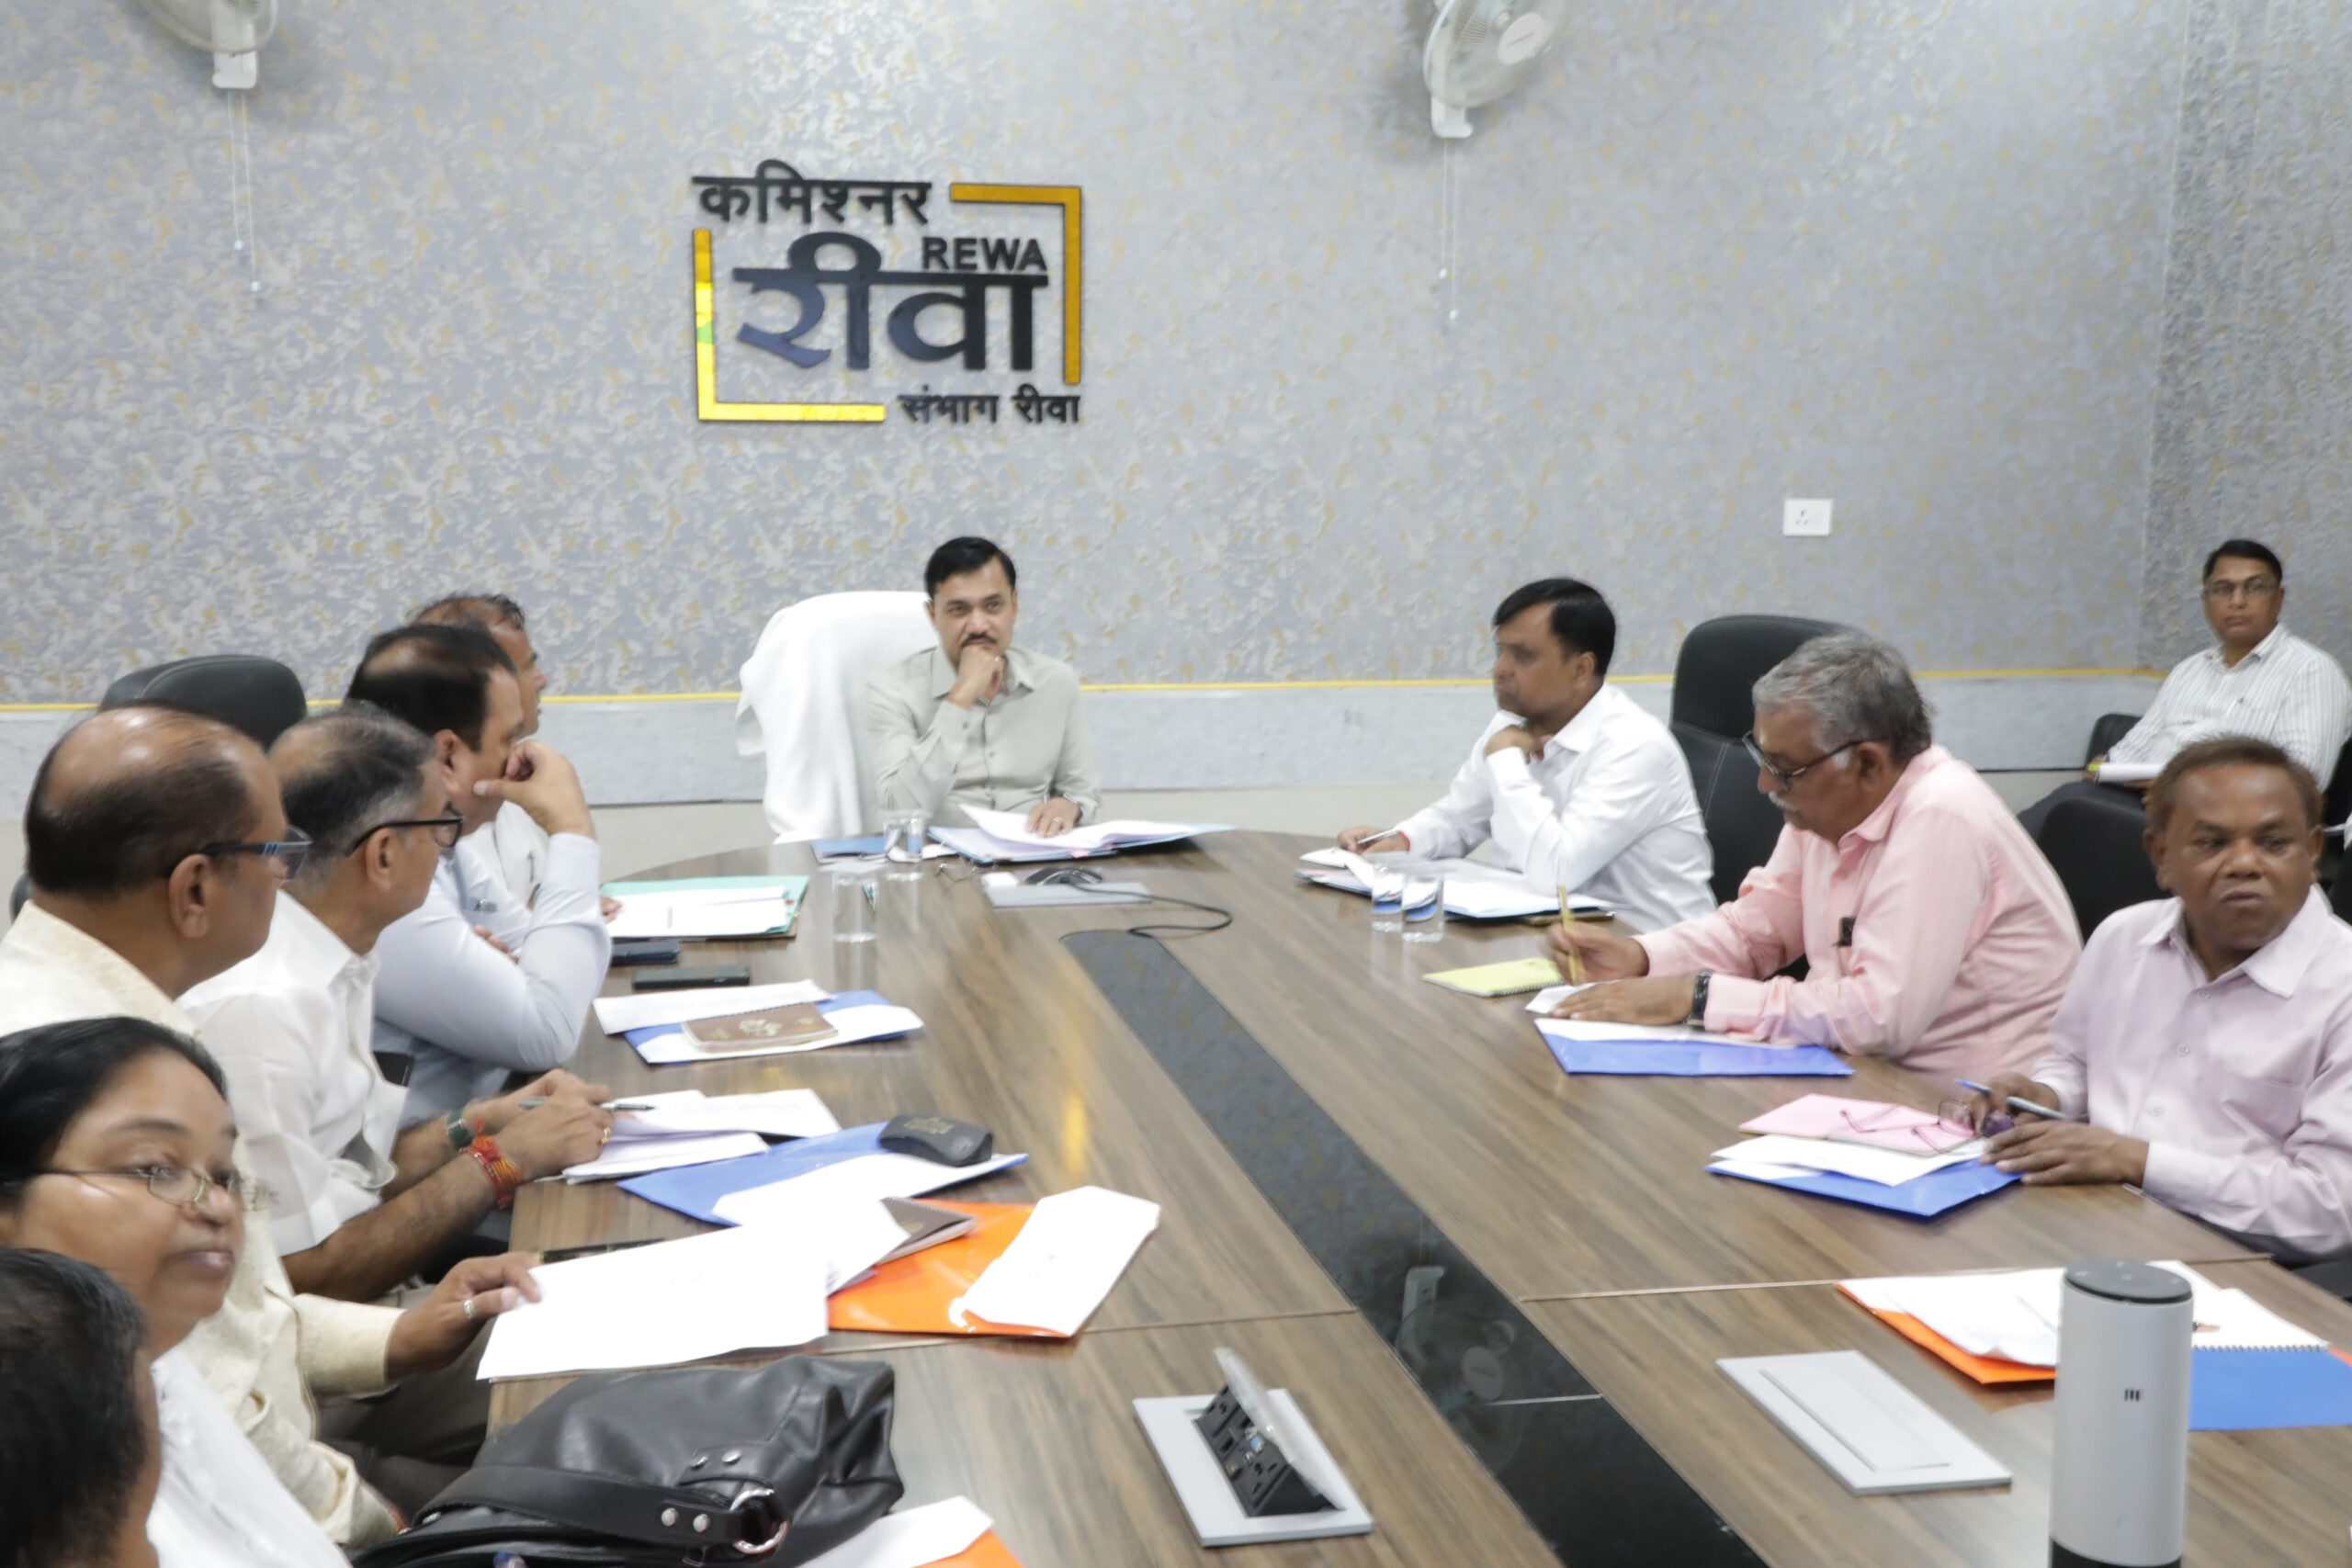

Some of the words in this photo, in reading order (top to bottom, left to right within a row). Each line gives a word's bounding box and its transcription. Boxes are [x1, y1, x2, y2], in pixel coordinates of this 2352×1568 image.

[692, 159, 933, 224] कमिश्नर
[922, 236, 1048, 271] REWA
[732, 231, 1049, 370] रीवा
[897, 383, 1000, 423] संभाग
[1011, 382, 1081, 423] रीवा
